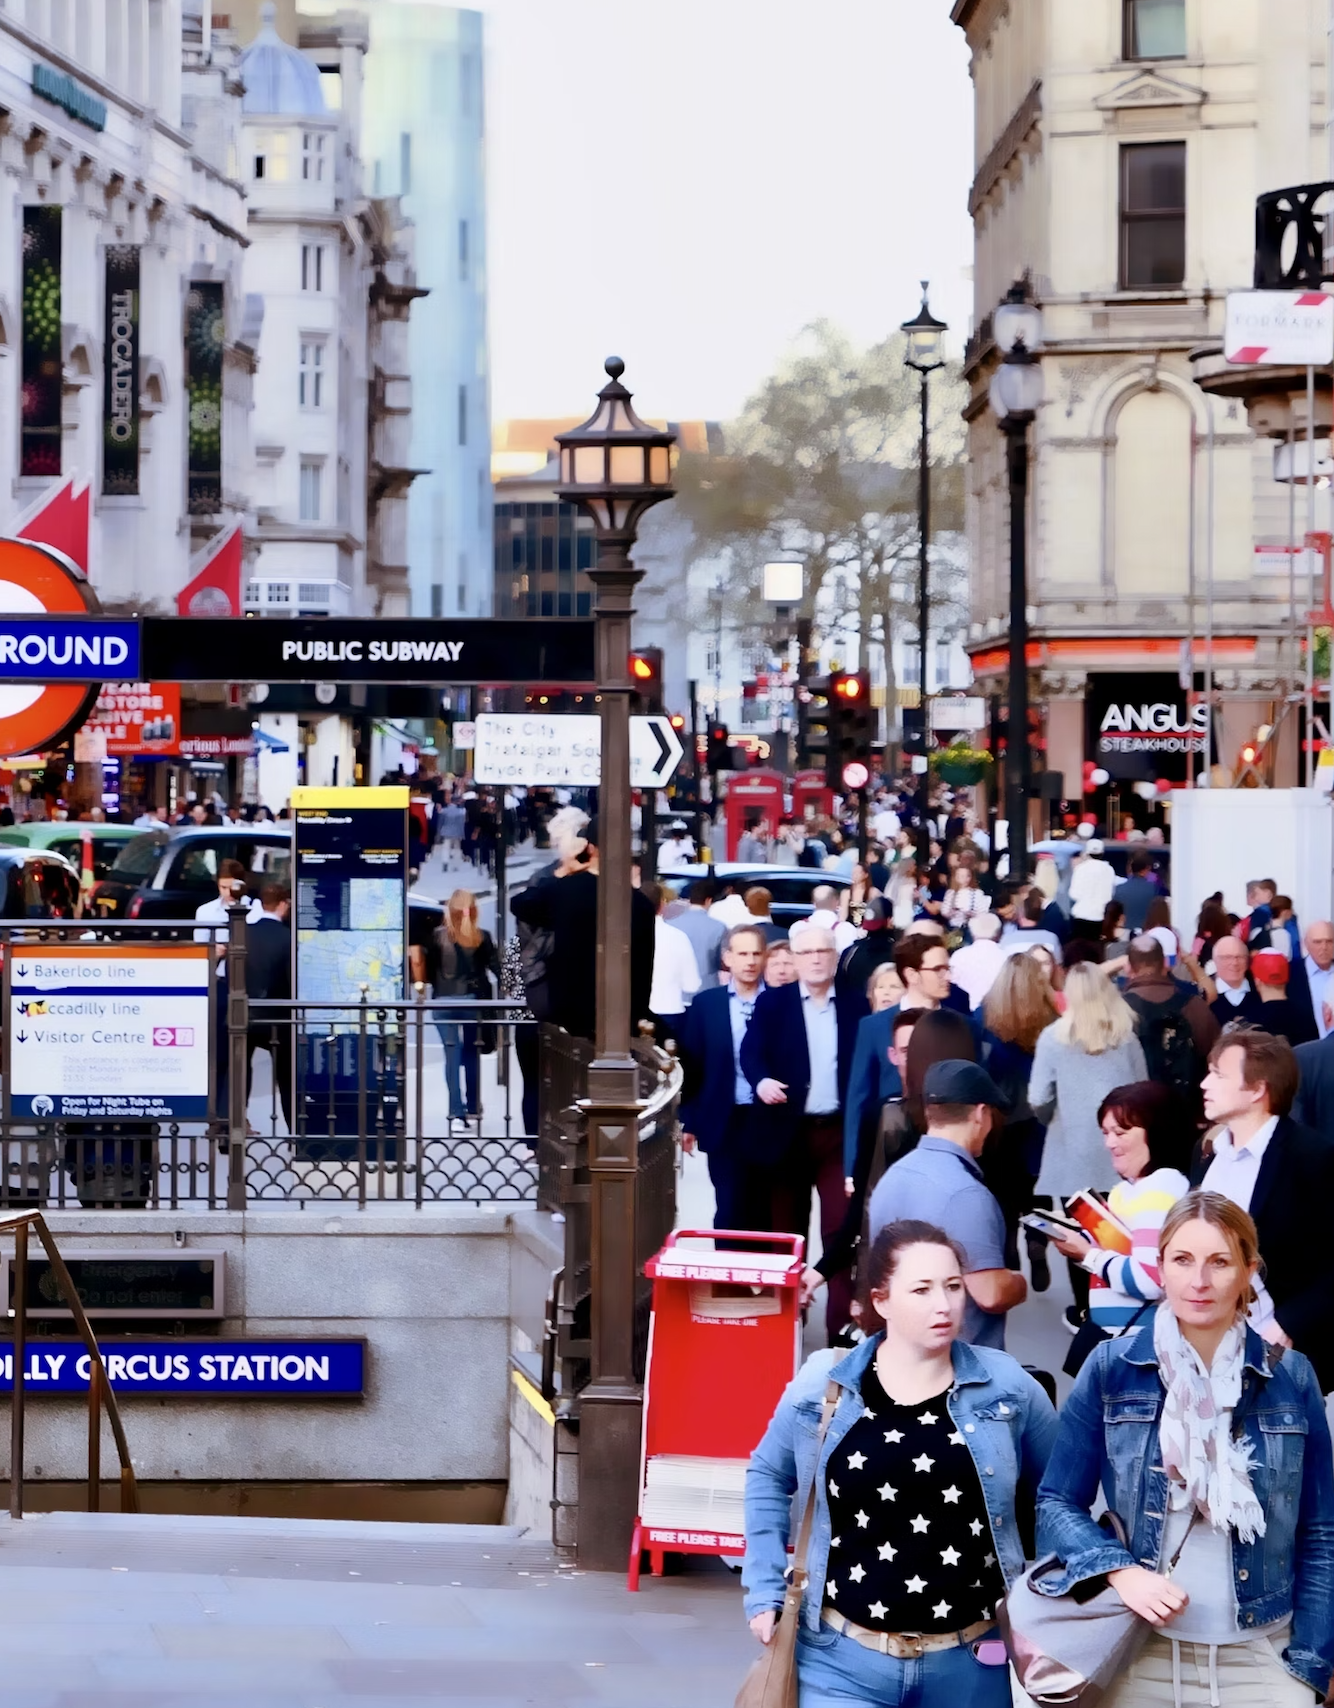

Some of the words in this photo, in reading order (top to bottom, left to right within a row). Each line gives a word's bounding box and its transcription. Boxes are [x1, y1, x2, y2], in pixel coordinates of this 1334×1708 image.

[111, 289, 133, 442] TROCADERO
[282, 640, 364, 662] PUBLIC
[367, 641, 465, 662] SUBWAY
[1099, 703, 1209, 733] ANGUS
[485, 721, 513, 735] The
[523, 721, 556, 738] City
[484, 742, 562, 758] Trafalgar
[34, 964, 102, 978] Bakerloo
[108, 965, 136, 978] line
[47, 1002, 107, 1018] ccadilly
[112, 1002, 141, 1015] line
[34, 1029, 85, 1044] Visitor
[92, 1029, 146, 1044] Centre
[61, 1097, 87, 1108] Open
[198, 1354, 330, 1381] STATION
